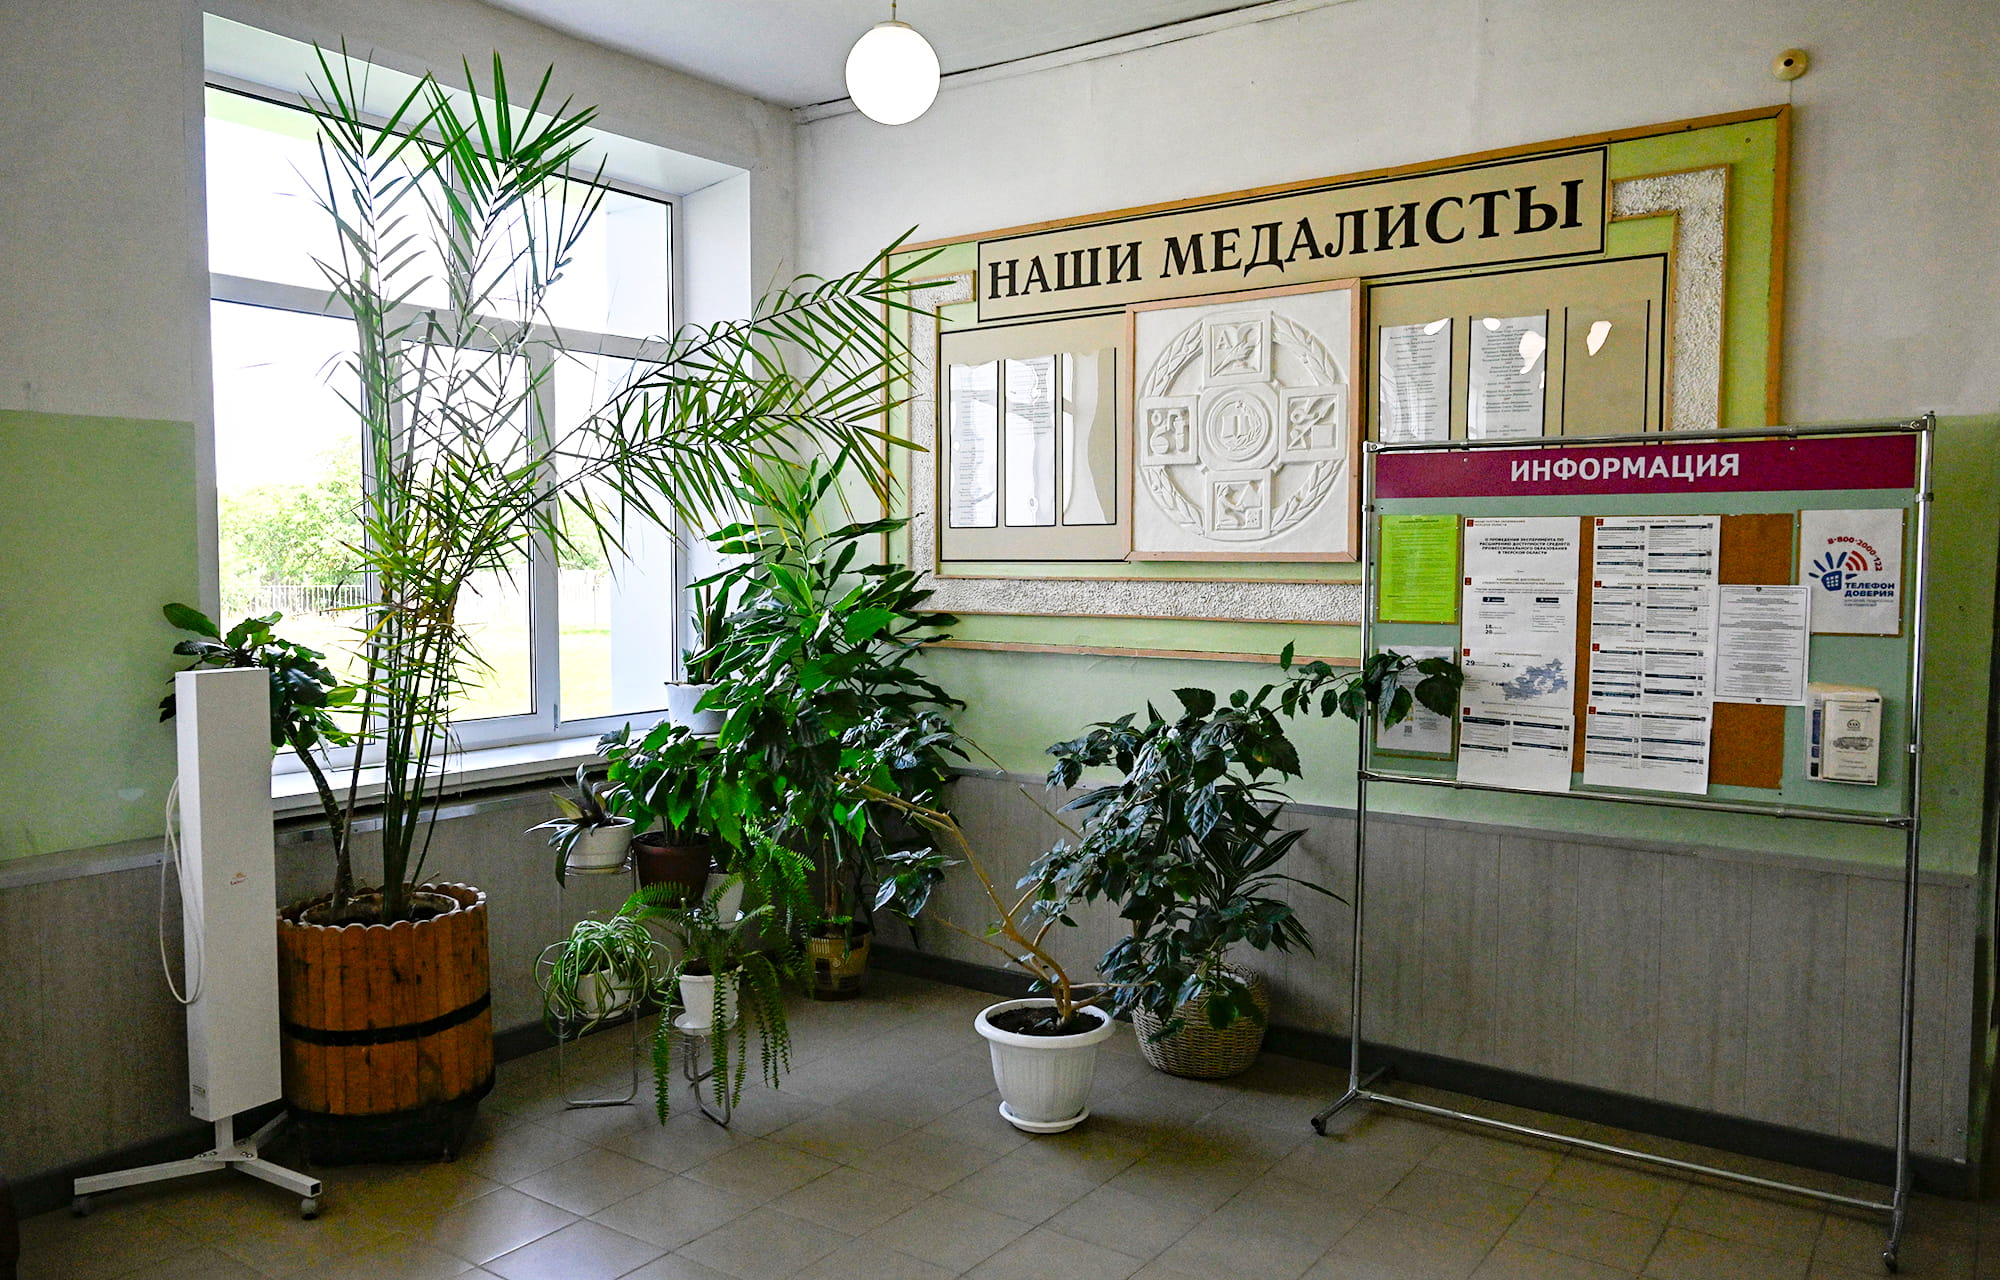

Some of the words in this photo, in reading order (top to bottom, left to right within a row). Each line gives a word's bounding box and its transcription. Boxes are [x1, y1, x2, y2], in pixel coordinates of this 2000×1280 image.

[987, 241, 1143, 299] НАШИ
[1160, 179, 1584, 278] МЕДАЛИСТЫ
[1511, 453, 1740, 482] ИНФОРМАЦИЯ
[1844, 590, 1894, 598] ДОВЕРИЯ
[1845, 582, 1895, 590] ТЕЛЕФОН
